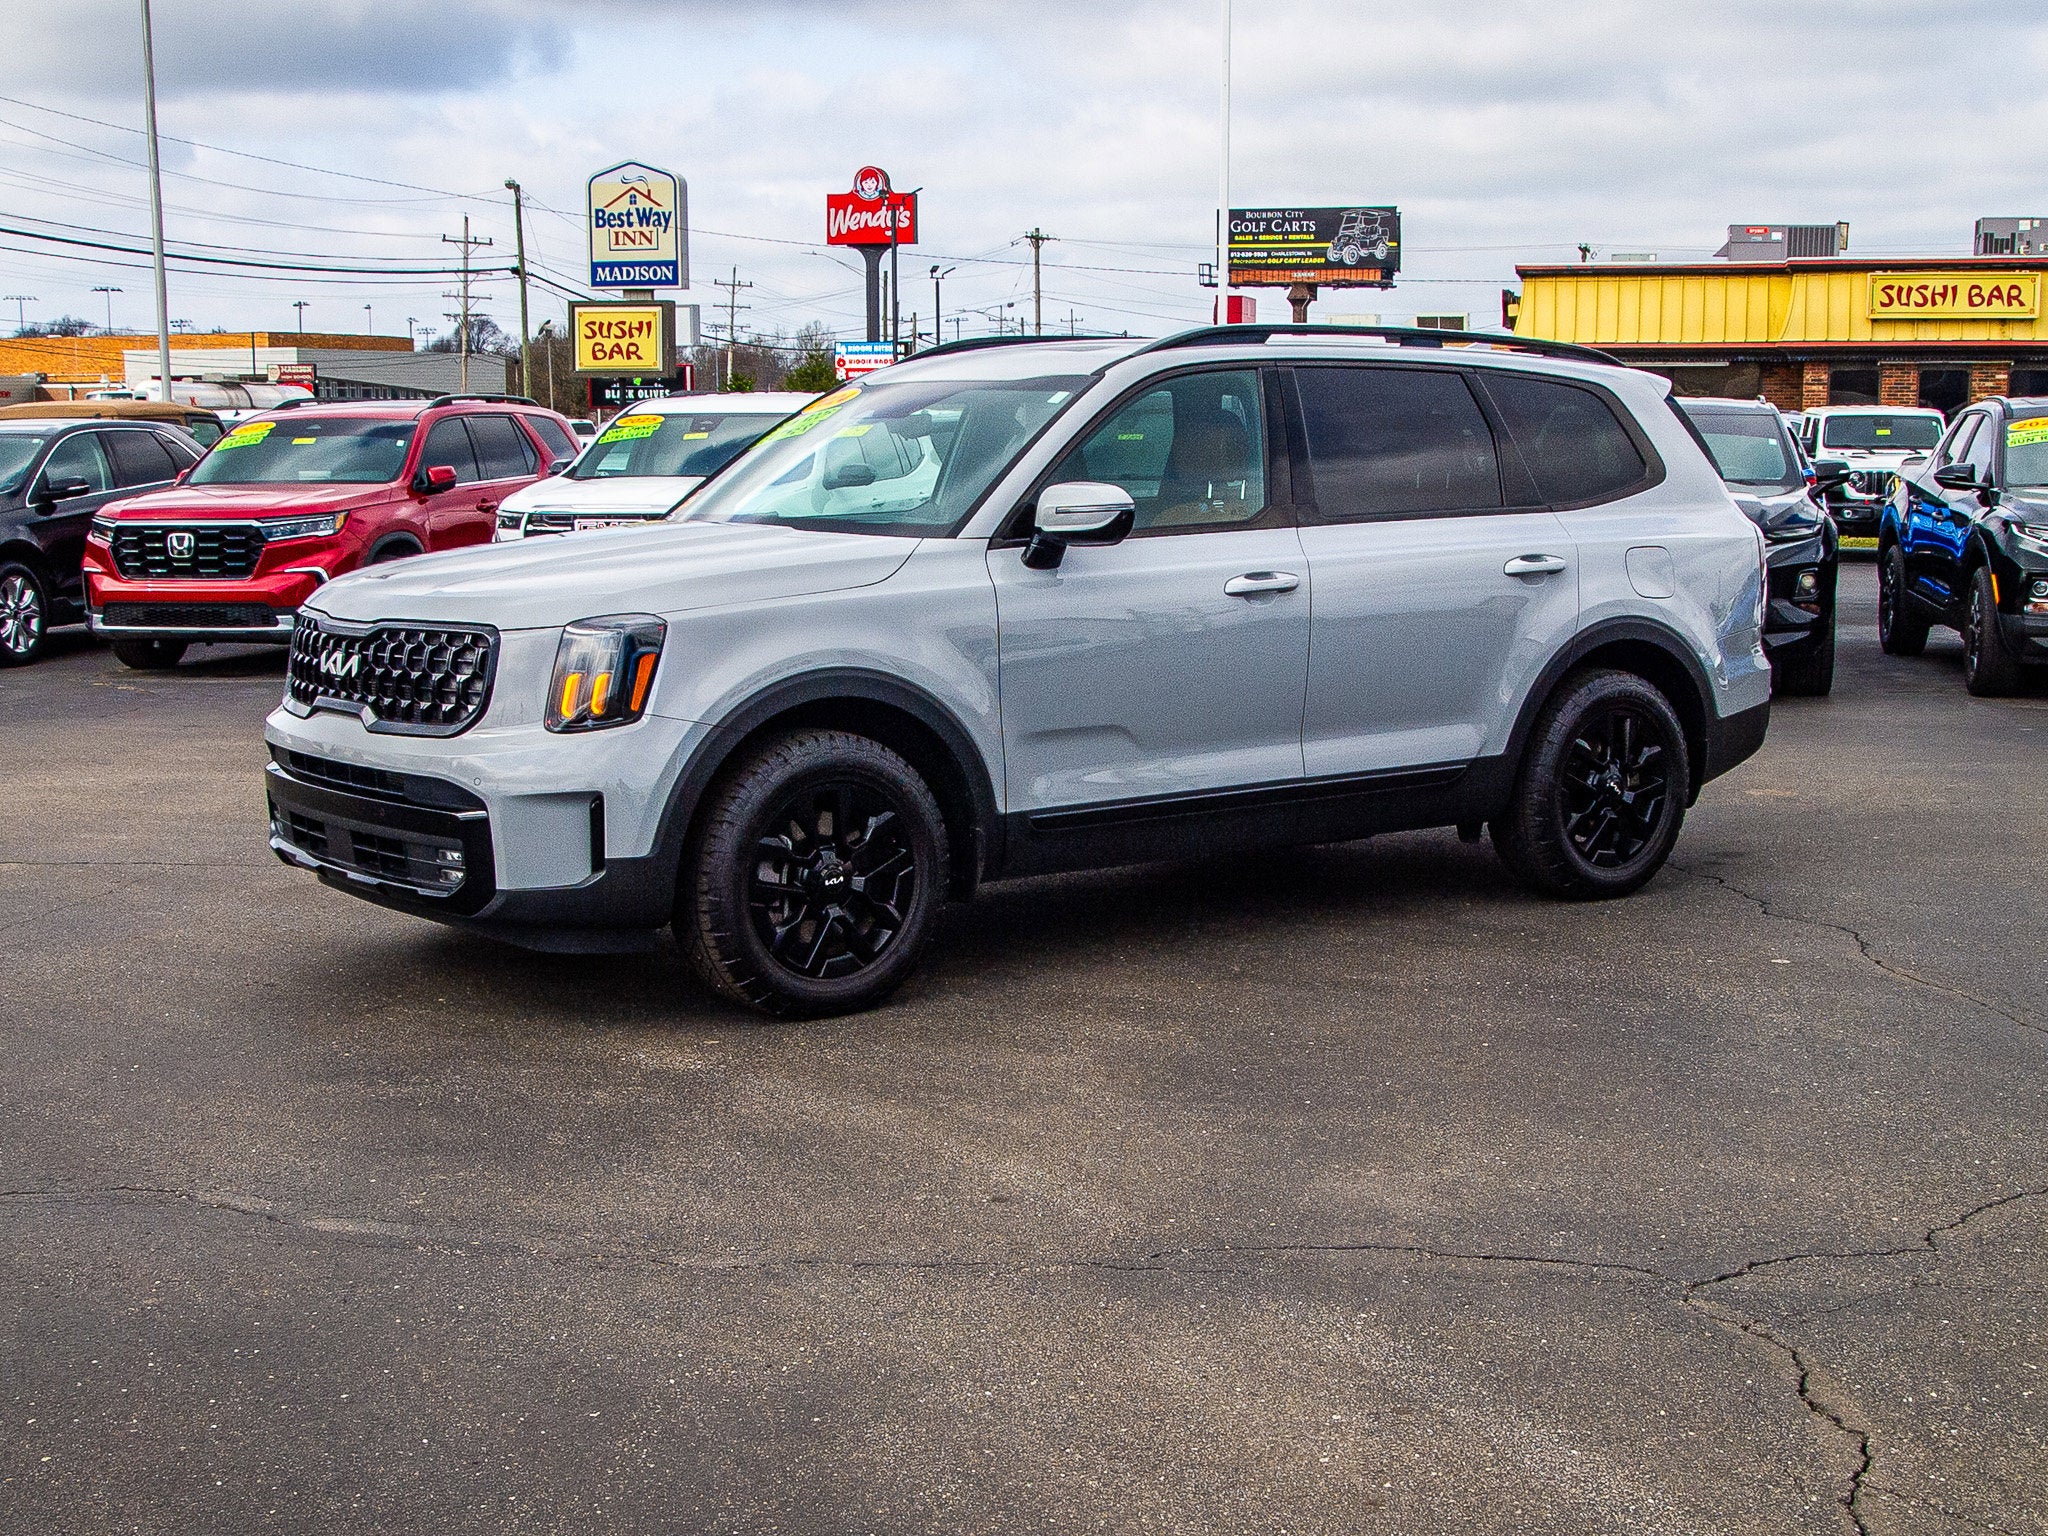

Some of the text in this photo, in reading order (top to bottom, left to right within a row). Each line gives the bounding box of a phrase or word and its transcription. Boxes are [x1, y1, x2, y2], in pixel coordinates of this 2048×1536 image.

[594, 206, 672, 234] Best Way
[829, 204, 911, 238] Wendy's
[1230, 219, 1316, 233] GOLF CARTS
[613, 230, 654, 246] INN
[595, 265, 674, 282] MADISON
[1879, 284, 2026, 308] SUSHI BAR
[584, 320, 652, 340] SUSHI
[592, 342, 643, 361] BAR
[605, 388, 670, 399] BLK OLIVES
